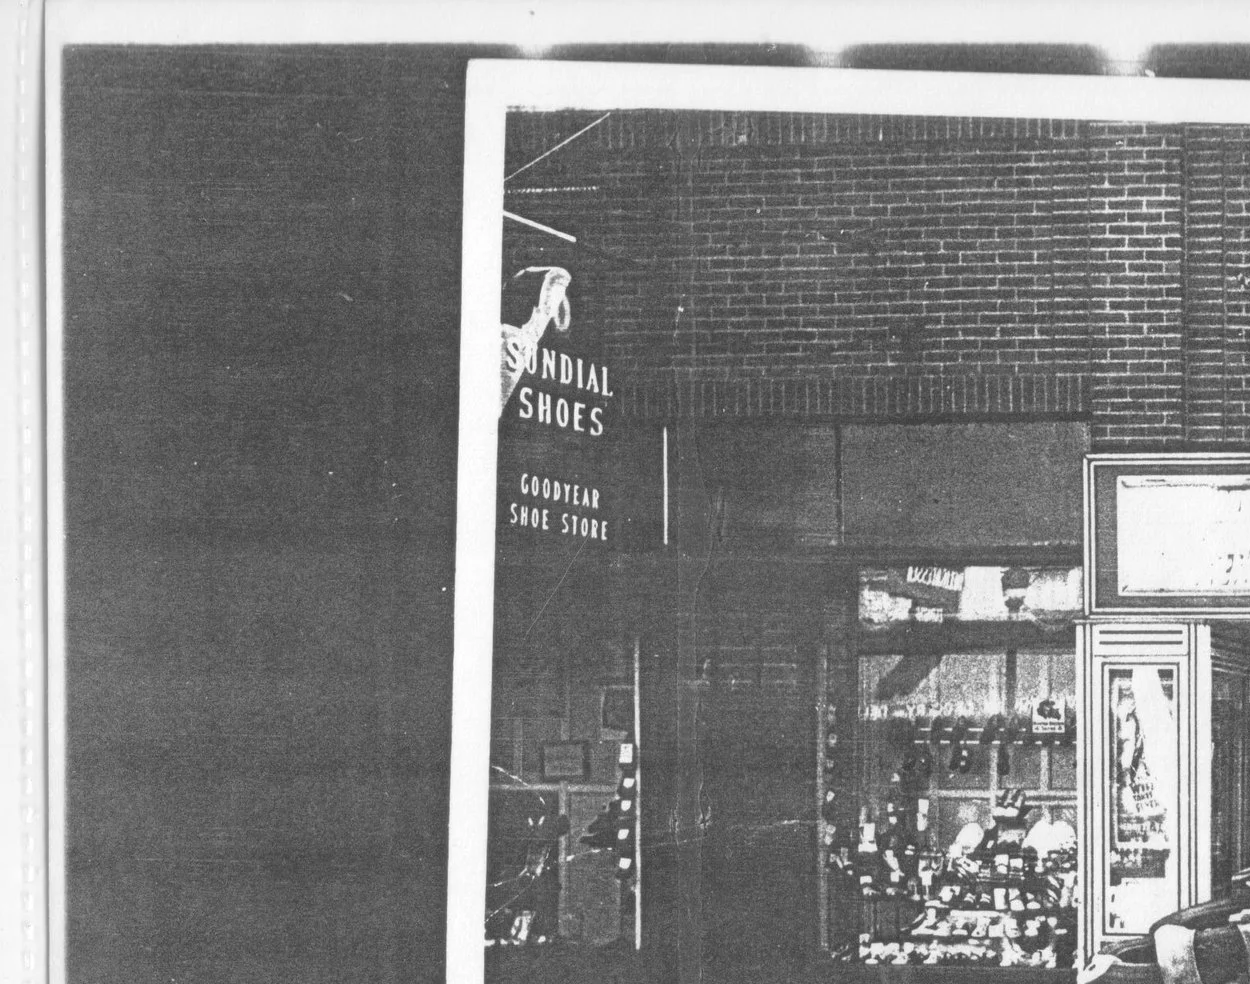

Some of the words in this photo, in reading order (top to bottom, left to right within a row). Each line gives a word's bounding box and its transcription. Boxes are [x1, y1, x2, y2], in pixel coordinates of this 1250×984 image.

[519, 386, 603, 436] SHOES
[521, 473, 600, 509] GOODYEAR
[510, 503, 550, 531] SHOE
[561, 513, 608, 541] STORE
